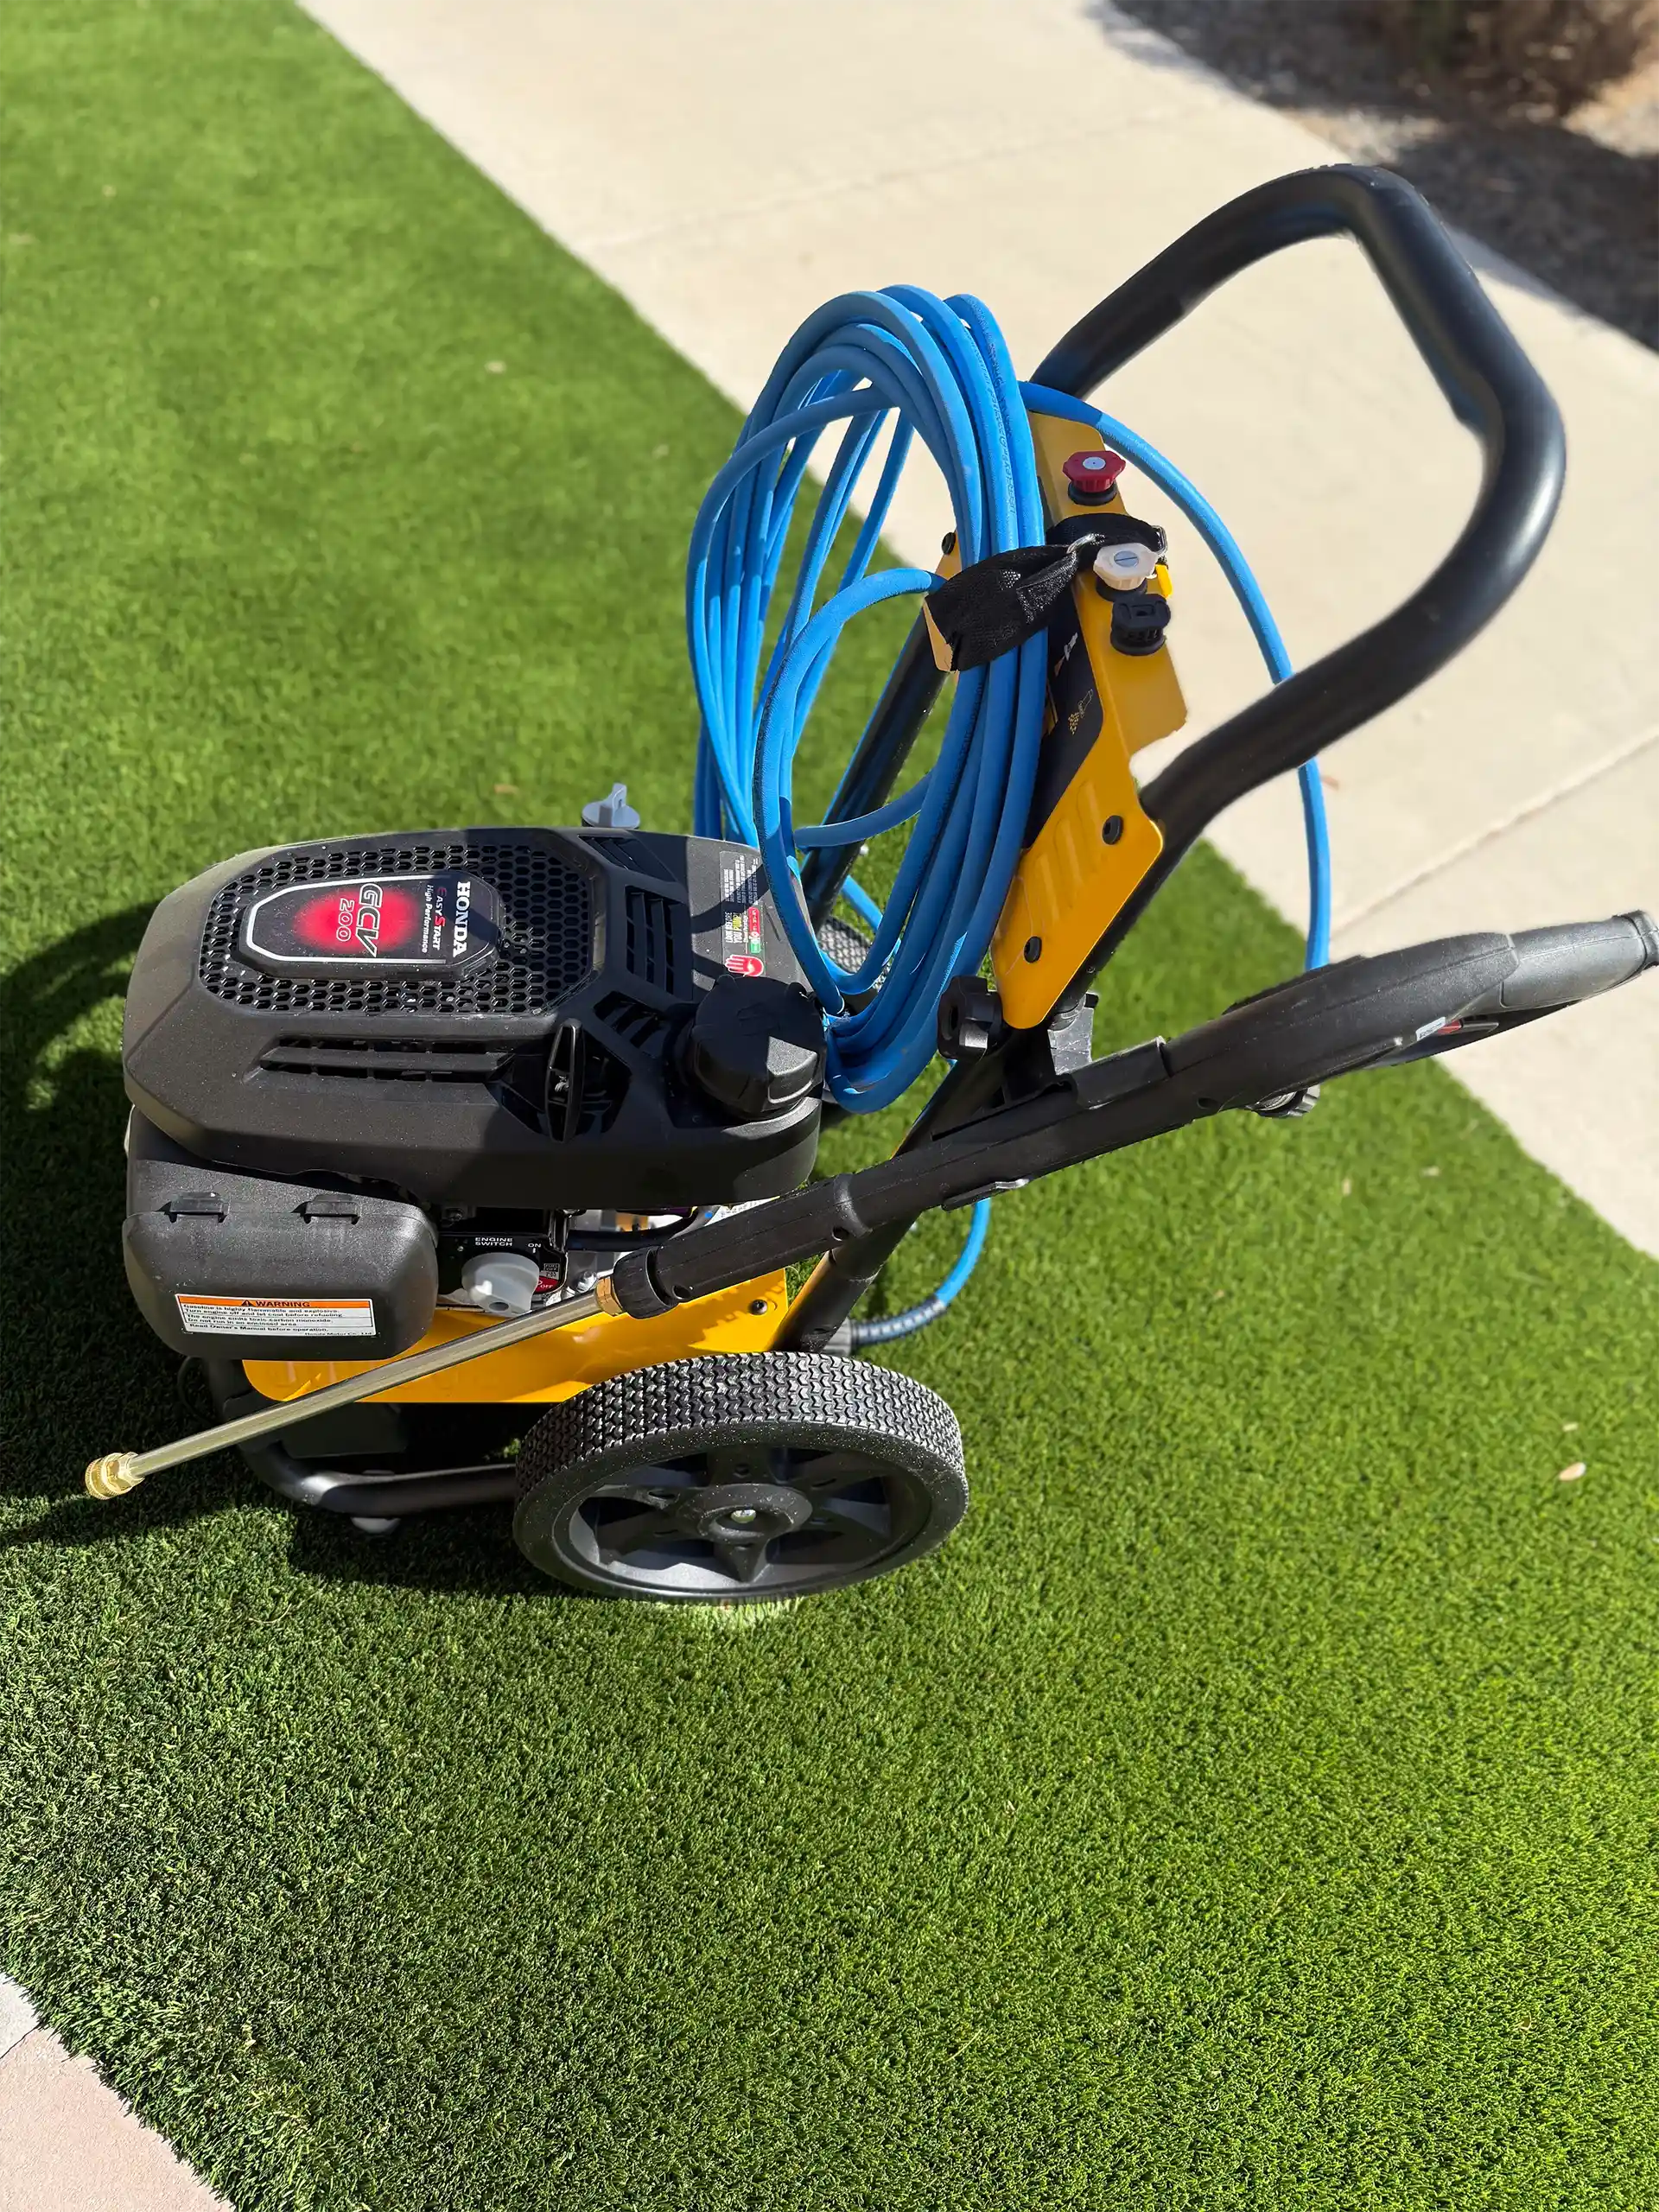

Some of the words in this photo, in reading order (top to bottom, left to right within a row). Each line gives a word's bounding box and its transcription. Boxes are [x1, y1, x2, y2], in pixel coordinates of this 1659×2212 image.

[424, 884, 435, 902] High
[335, 897, 355, 942] 200
[354, 882, 384, 958] GCV
[421, 903, 433, 954] Performance
[452, 880, 471, 958] HONDA
